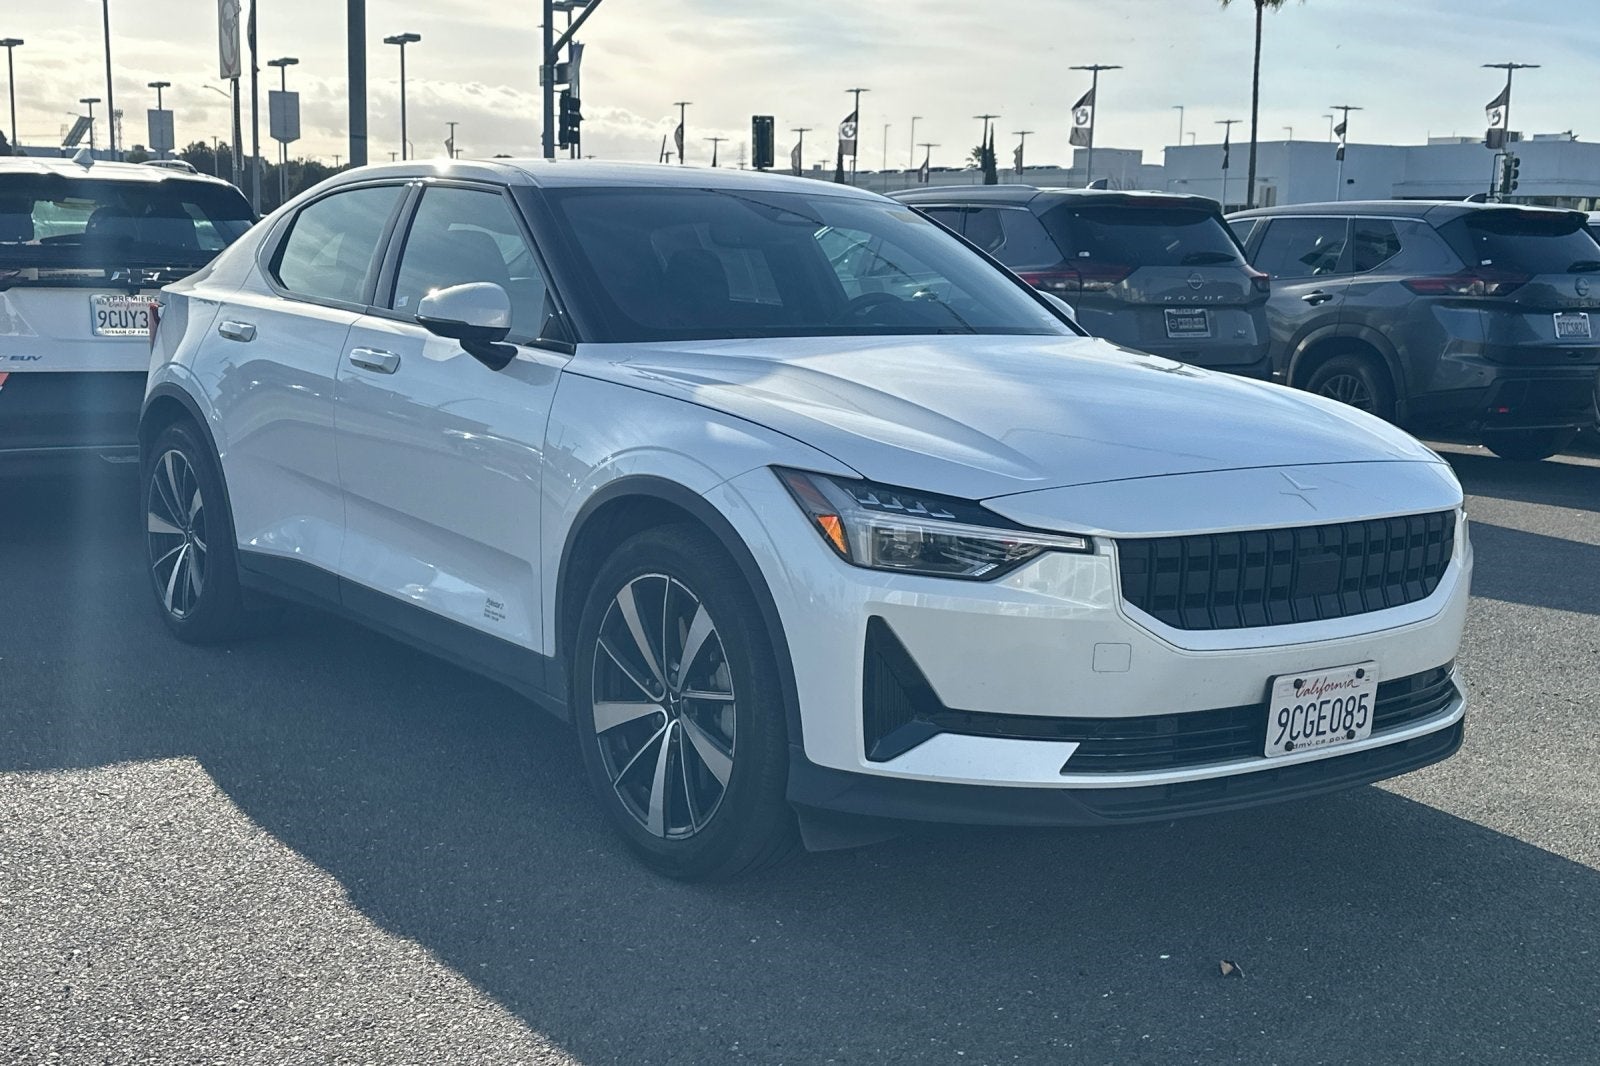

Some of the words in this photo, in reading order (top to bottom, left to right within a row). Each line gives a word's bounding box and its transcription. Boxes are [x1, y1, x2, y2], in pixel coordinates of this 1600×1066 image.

[112, 295, 152, 303] PREMIER
[97, 310, 149, 328] 9CUY3
[1295, 676, 1360, 700] California
[1273, 693, 1370, 746] 9CGE085
